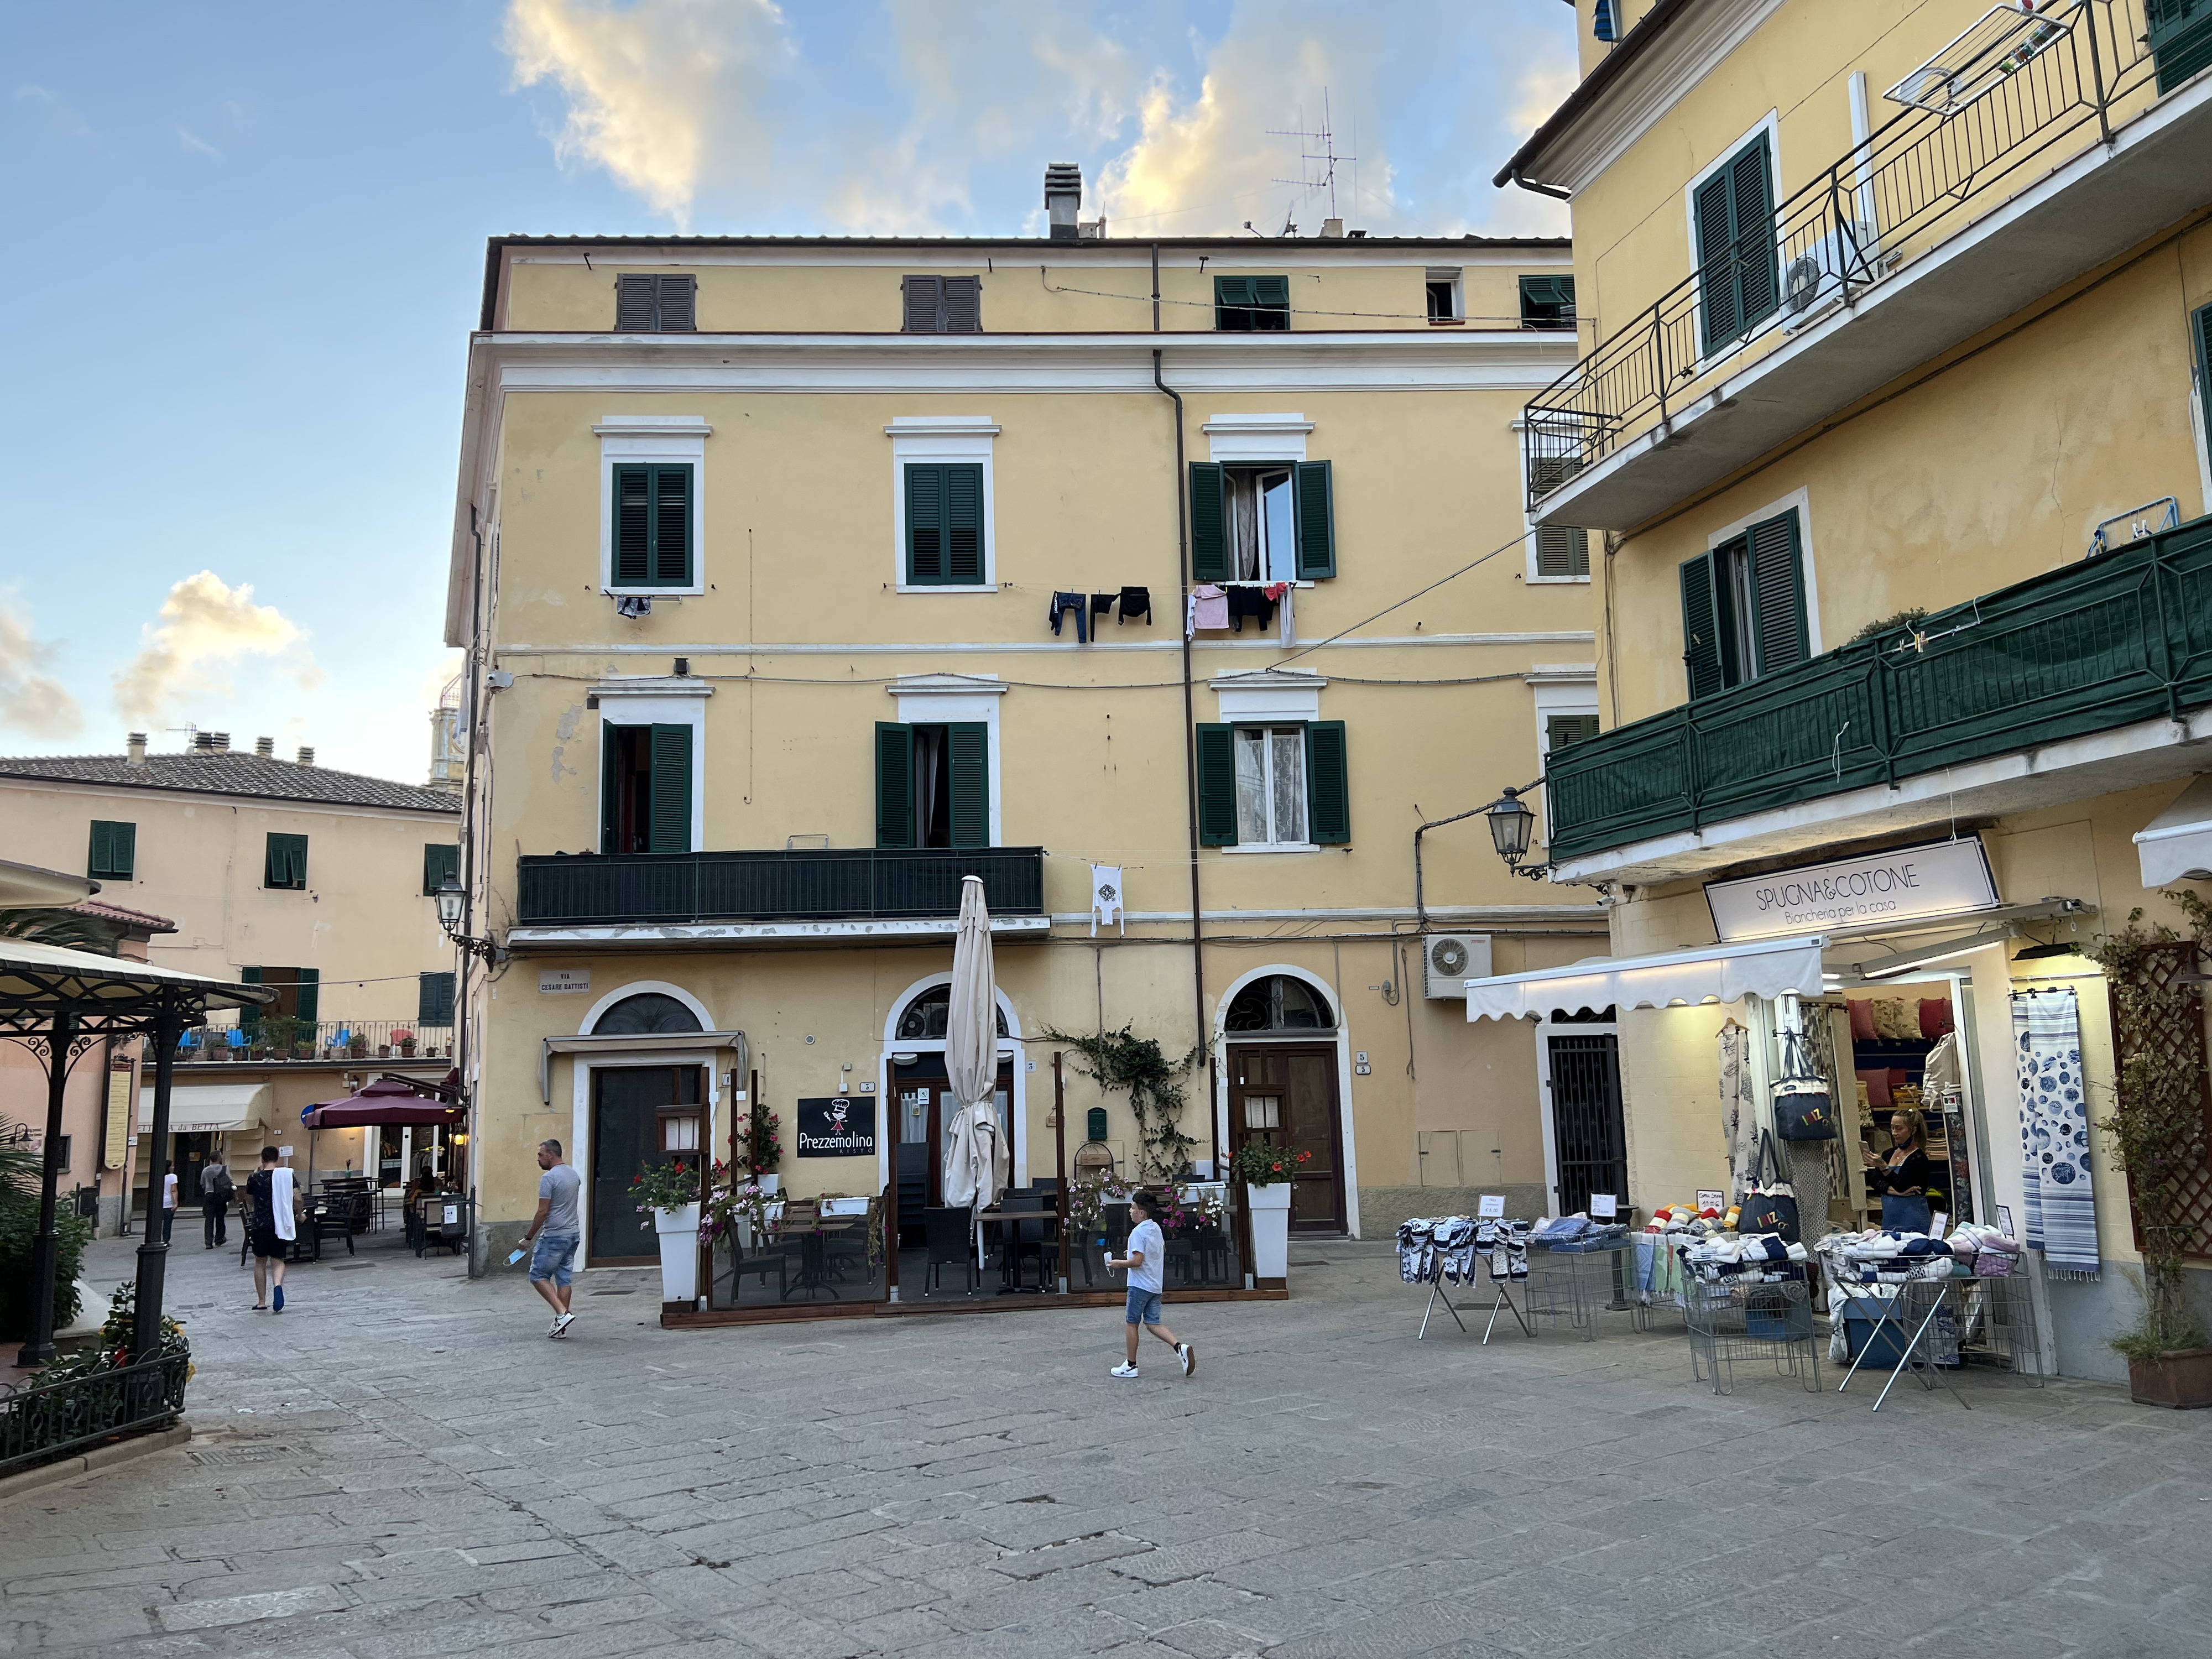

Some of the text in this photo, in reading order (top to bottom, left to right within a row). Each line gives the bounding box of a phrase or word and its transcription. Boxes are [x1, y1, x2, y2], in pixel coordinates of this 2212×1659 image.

[1756, 864, 1919, 910] SPUGNA&COTONE
[1785, 900, 1896, 925] Biancheria per la casa
[800, 1131, 873, 1149] Prezzemolina
